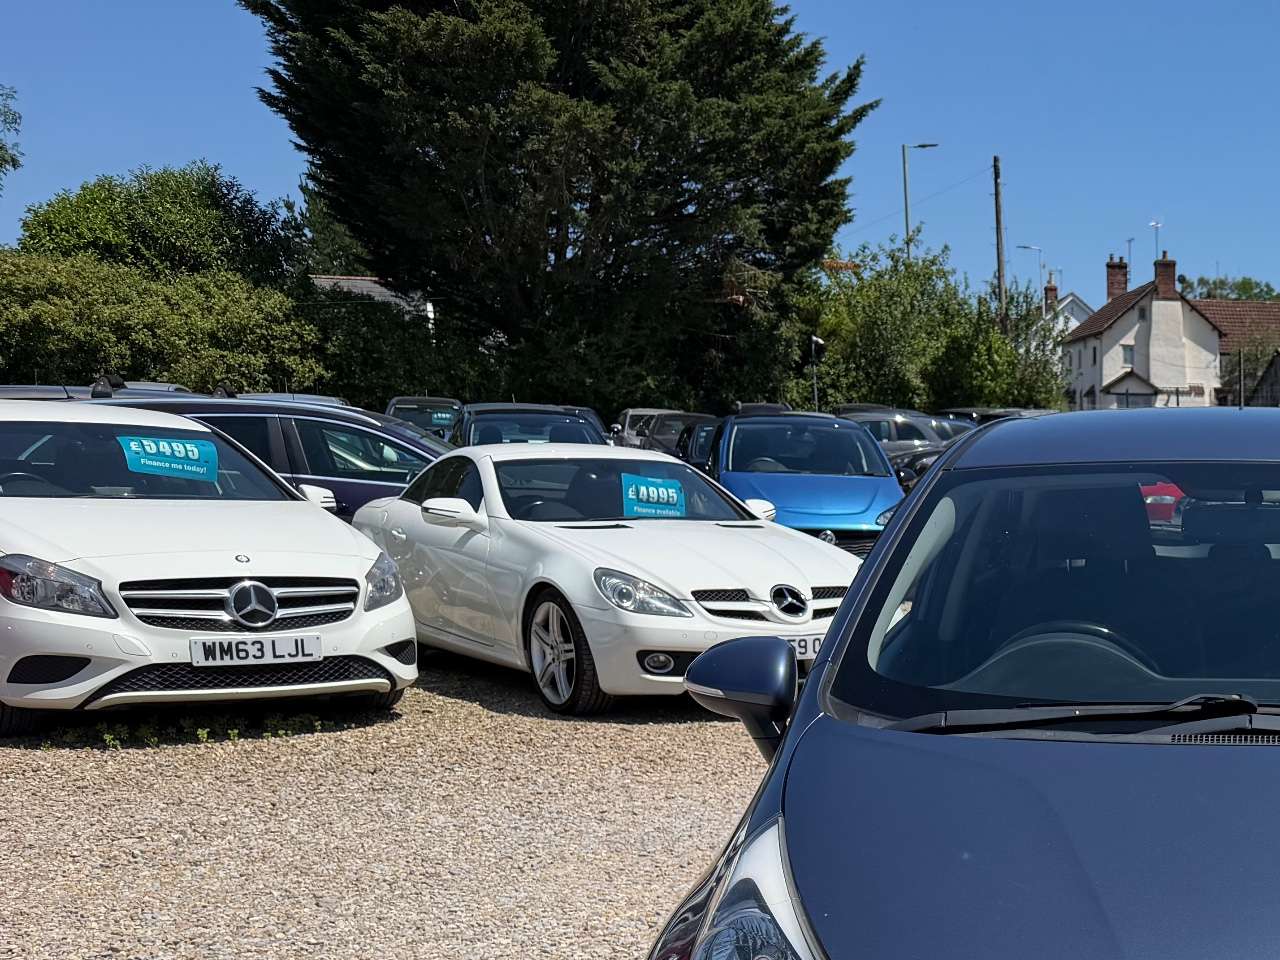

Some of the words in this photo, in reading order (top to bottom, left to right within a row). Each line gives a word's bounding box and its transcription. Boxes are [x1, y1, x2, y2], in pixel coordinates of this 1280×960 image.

[129, 440, 199, 460] £5495
[141, 458, 170, 468] Finance
[171, 462, 183, 470] me
[628, 484, 678, 504] £4995
[202, 640, 265, 661] WM63
[271, 638, 314, 659] LJL
